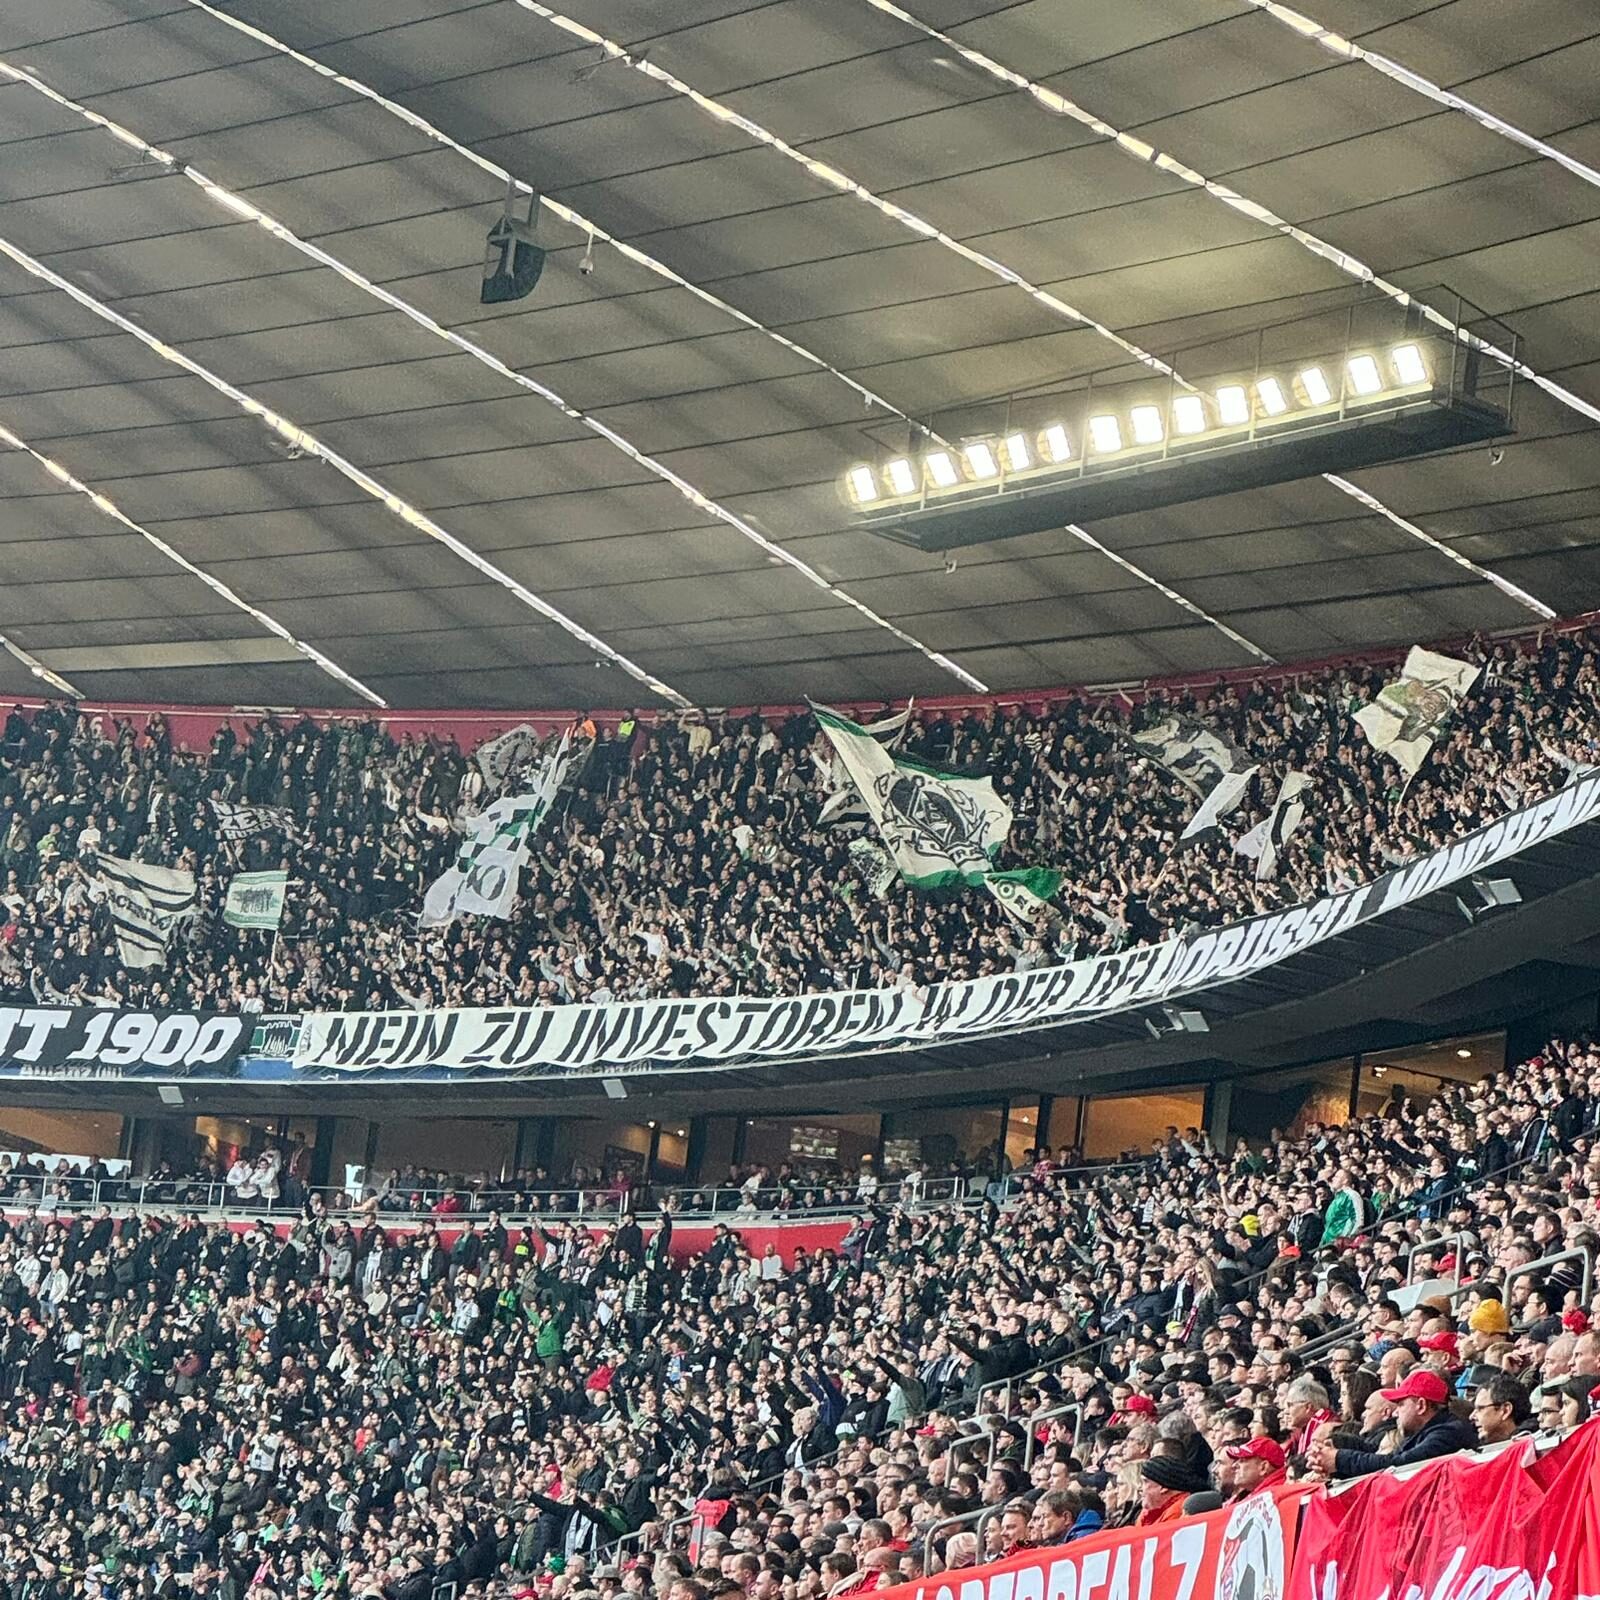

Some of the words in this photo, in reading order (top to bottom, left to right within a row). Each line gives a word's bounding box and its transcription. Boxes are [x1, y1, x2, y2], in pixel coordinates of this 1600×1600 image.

[1174, 885, 1373, 986] ORUSSIA
[66, 1012, 243, 1066] 1900
[314, 1012, 460, 1065] NEIN
[461, 1010, 556, 1065] ZU
[555, 992, 903, 1063] INVESTOREN
[957, 968, 1075, 1029] DER
[936, 1522, 1207, 1600] PFALZ
